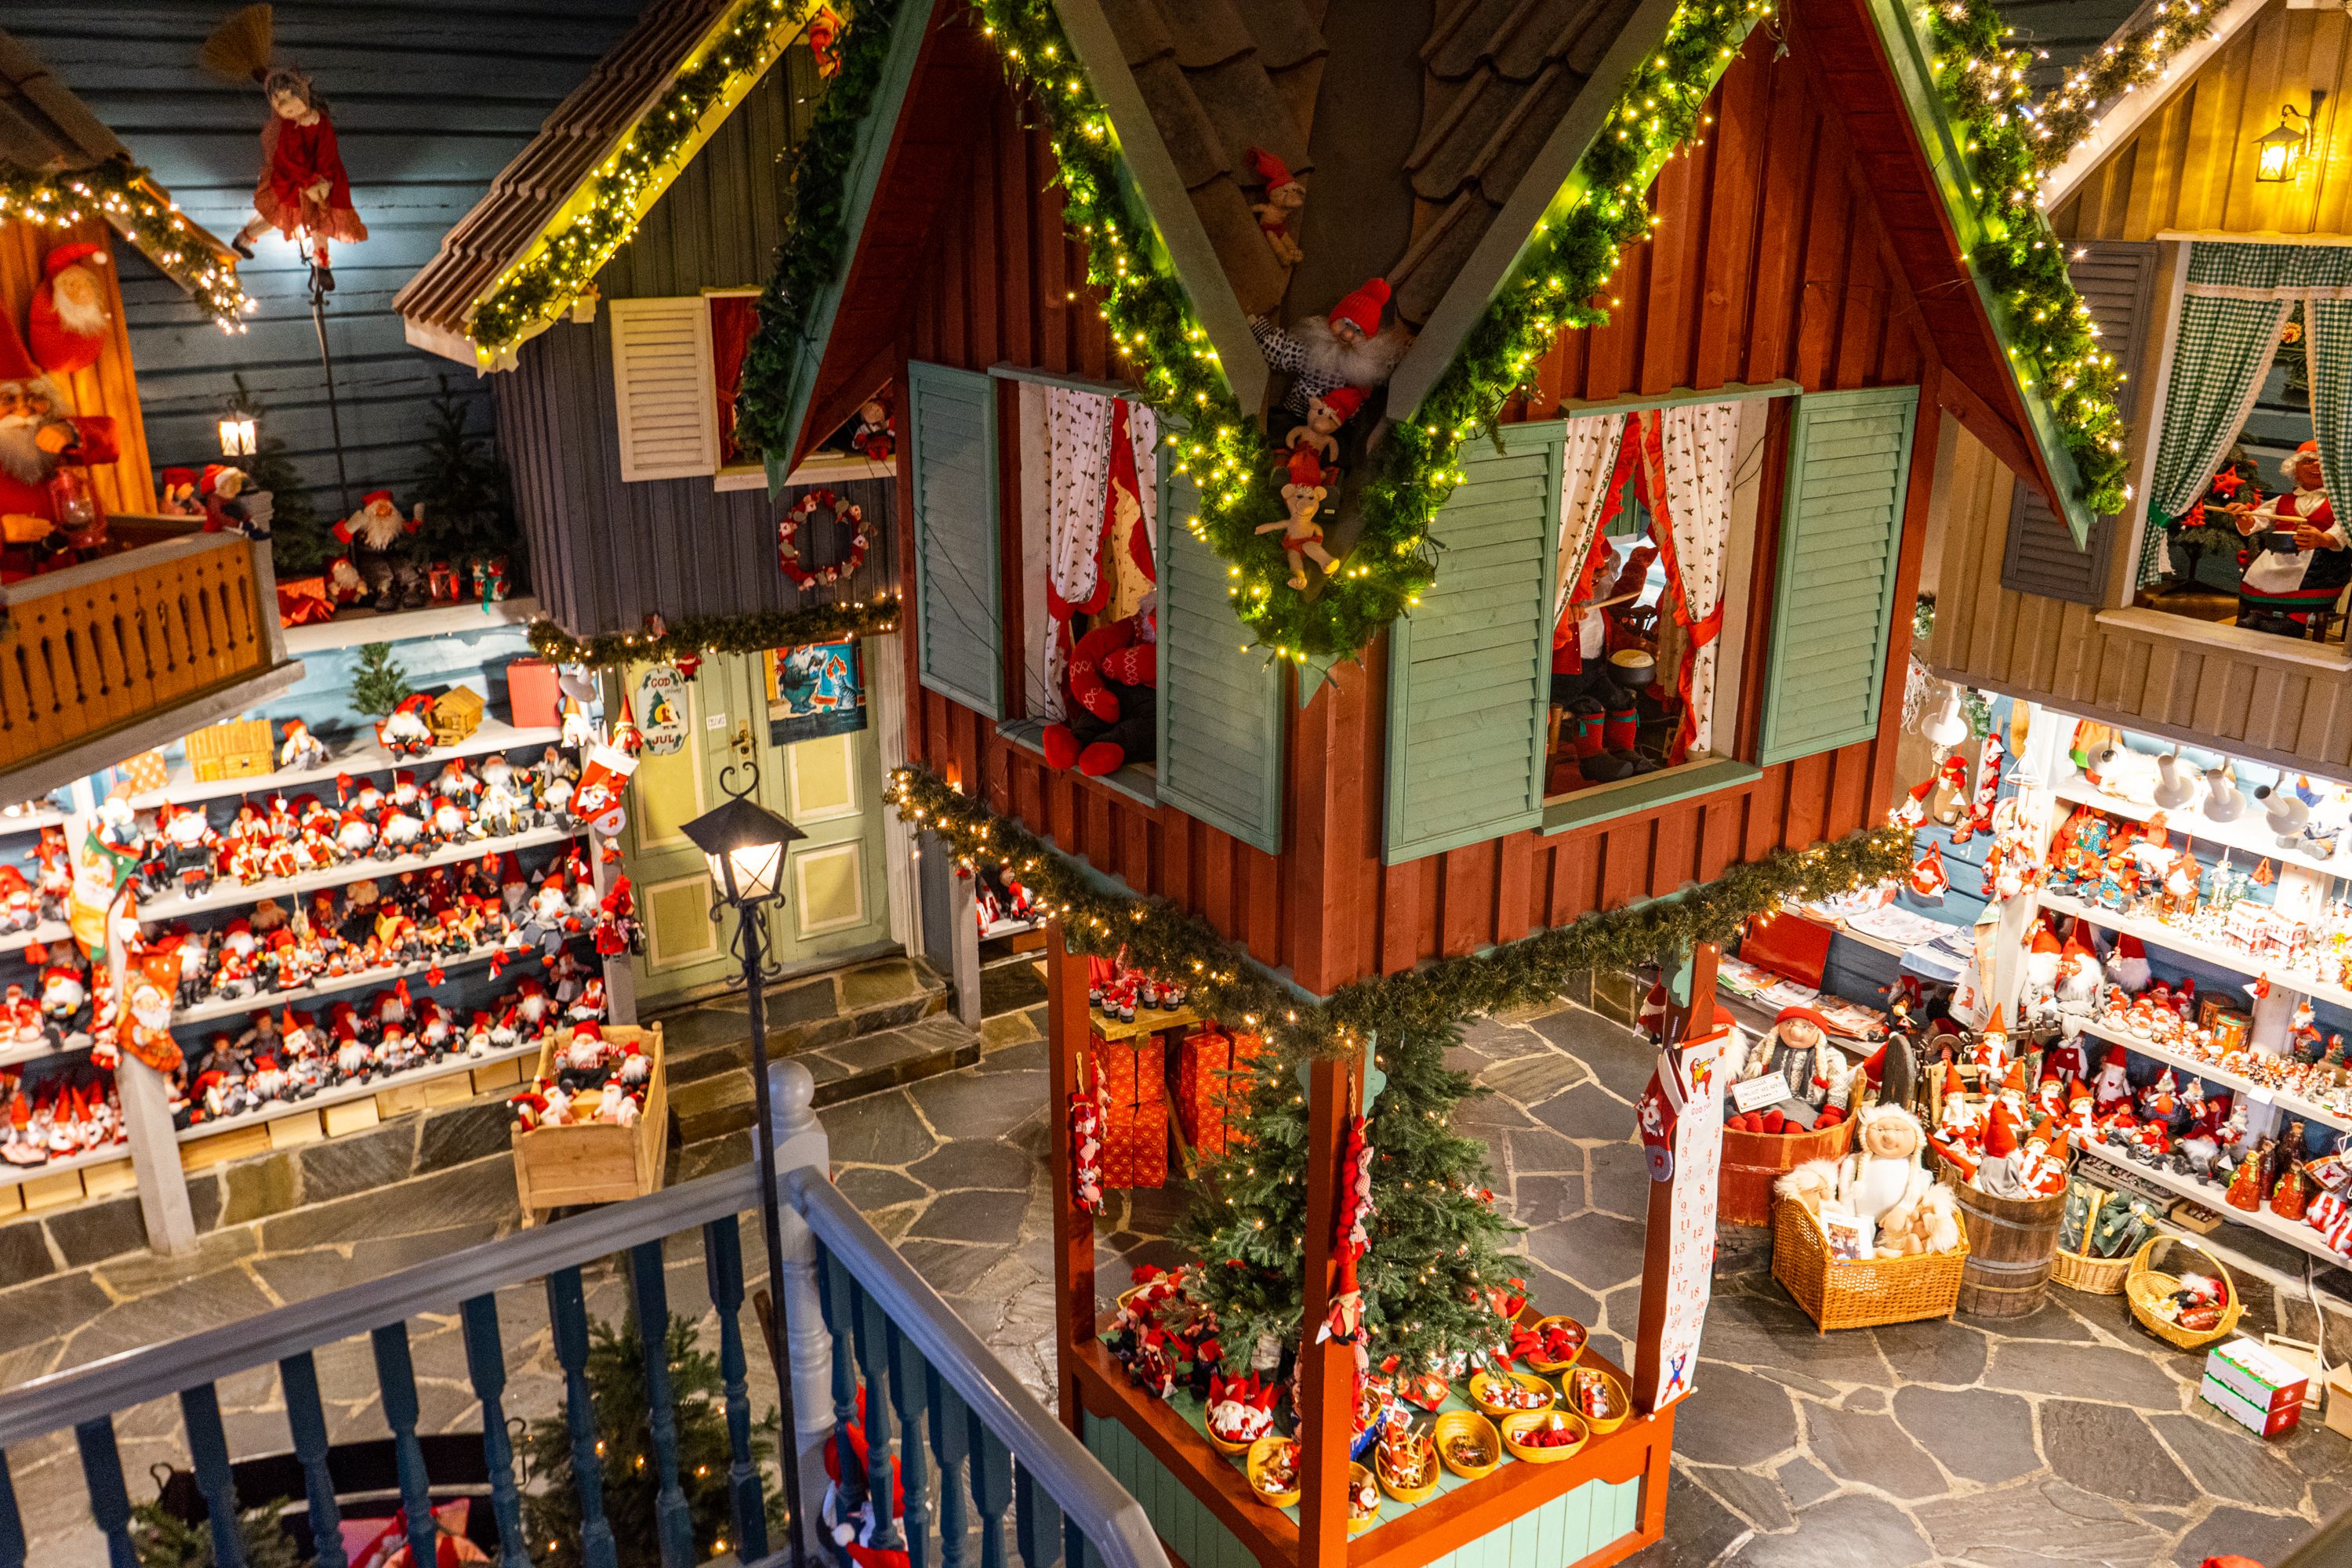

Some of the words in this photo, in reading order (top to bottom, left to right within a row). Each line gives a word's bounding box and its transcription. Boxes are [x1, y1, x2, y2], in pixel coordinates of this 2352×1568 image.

[652, 735, 674, 745] JUL
[1682, 1146, 1687, 1158] 3
[1677, 1187, 1682, 1198] 7
[1700, 1184, 1705, 1196] 8
[1681, 1201, 1686, 1212] 9
[1703, 1203, 1713, 1215] 10
[1681, 1219, 1690, 1230] 11
[1693, 1226, 1704, 1238] 12
[1675, 1242, 1685, 1254] 13
[1700, 1243, 1710, 1254] 14
[1672, 1263, 1682, 1275] 15
[1677, 1279, 1688, 1291] 17
[1690, 1287, 1699, 1299] 18
[1670, 1304, 1680, 1316] 19
